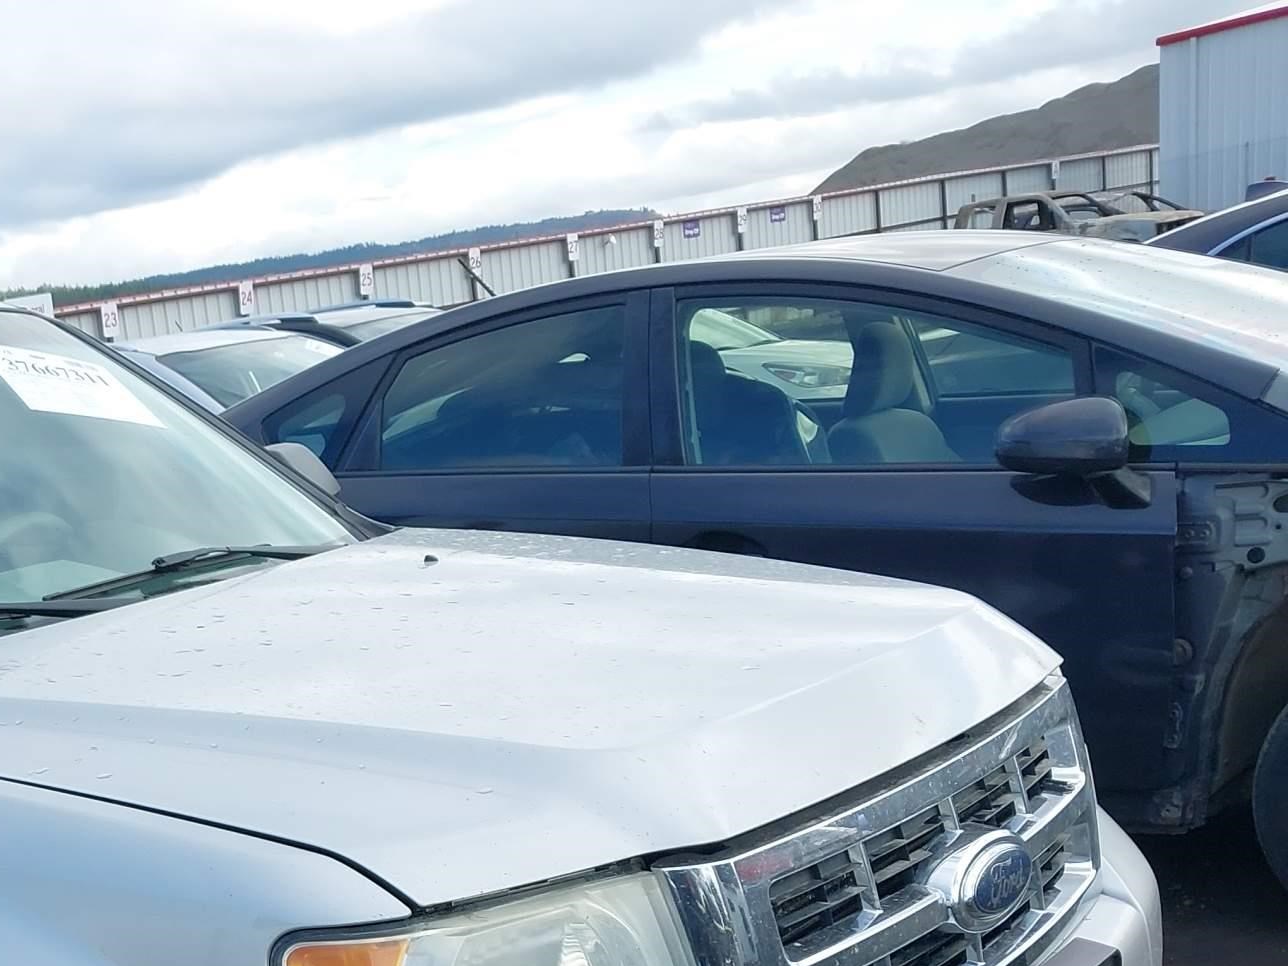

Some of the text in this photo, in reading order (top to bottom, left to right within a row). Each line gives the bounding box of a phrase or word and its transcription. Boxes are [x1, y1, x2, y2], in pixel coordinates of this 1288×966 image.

[568, 241, 578, 254] 27
[471, 256, 481, 269] 26
[362, 272, 373, 287] 25
[241, 291, 253, 306] 24
[103, 313, 118, 328] 23
[1, 356, 110, 388] 37667311
[990, 856, 1026, 904] Ford
